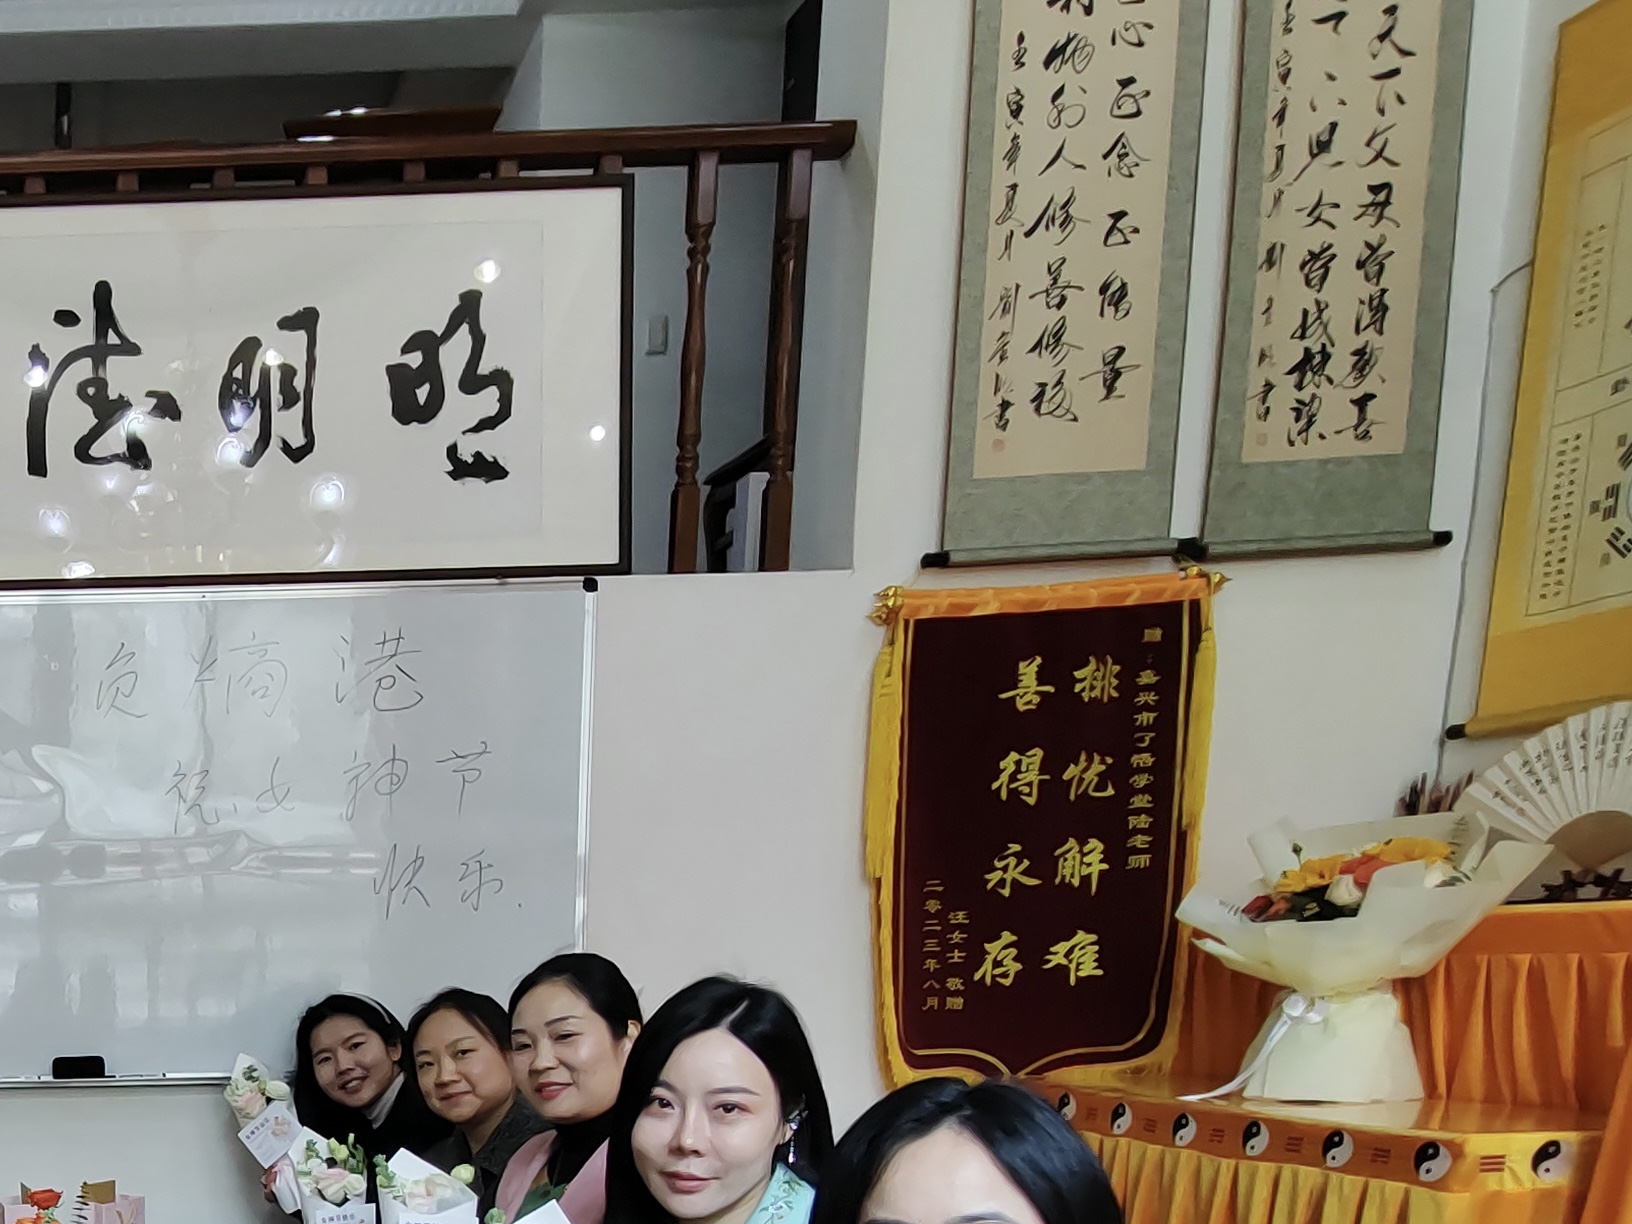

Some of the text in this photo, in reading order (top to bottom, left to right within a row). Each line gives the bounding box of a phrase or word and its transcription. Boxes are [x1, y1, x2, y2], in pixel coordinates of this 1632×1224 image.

[921, 880, 945, 1011] 二零二三年八月
[973, 655, 1055, 987] 善得永存
[1042, 655, 1121, 986] 排忧解难
